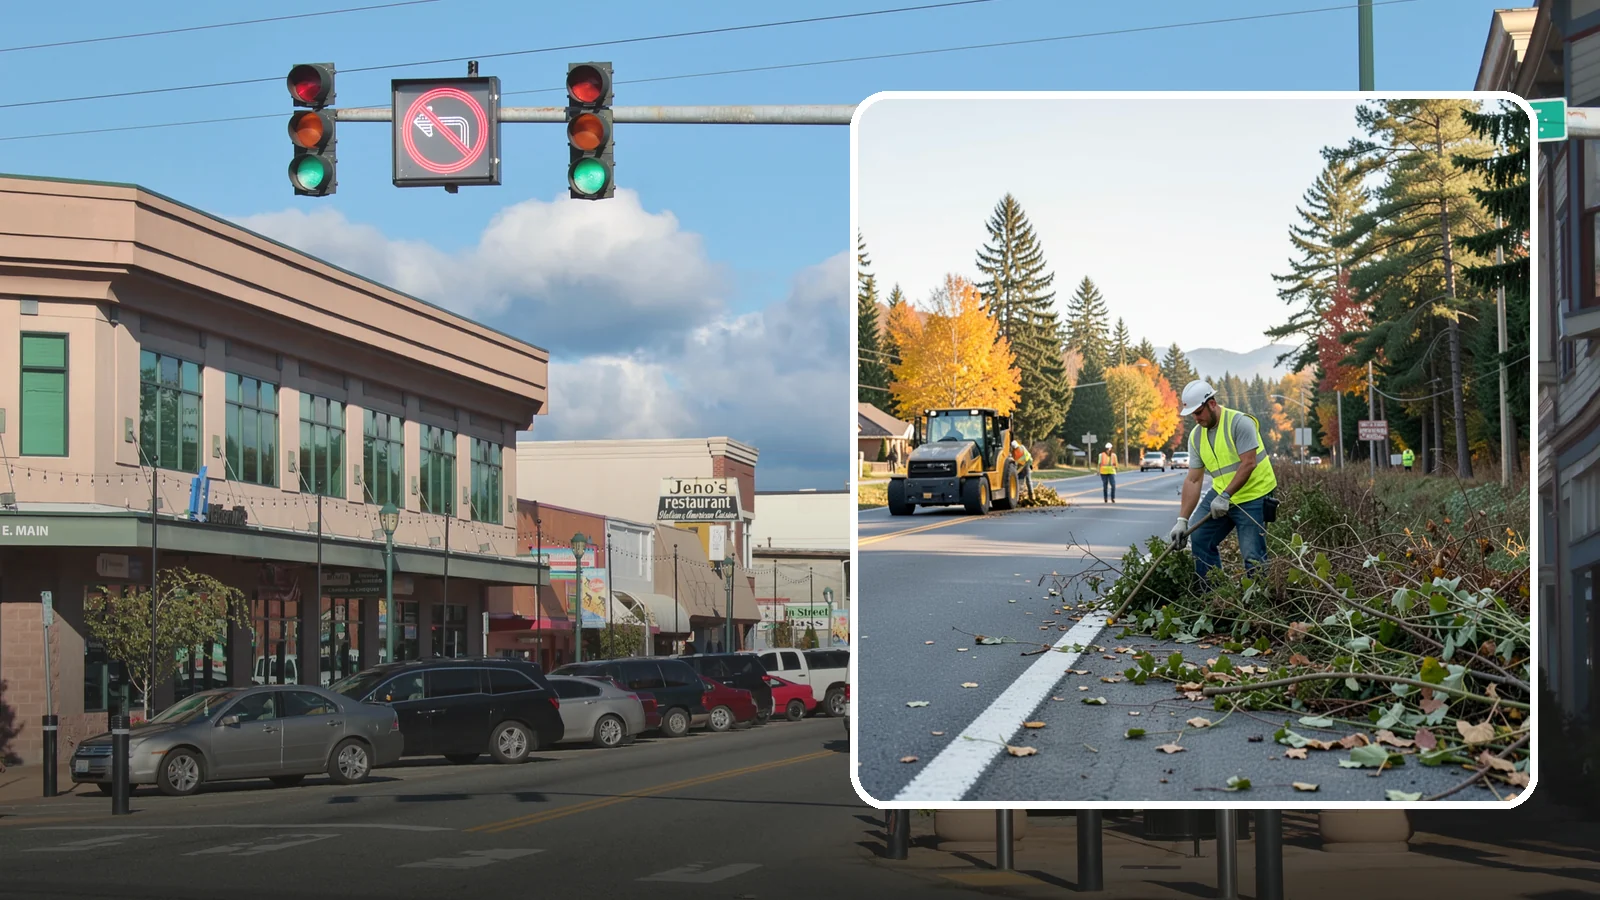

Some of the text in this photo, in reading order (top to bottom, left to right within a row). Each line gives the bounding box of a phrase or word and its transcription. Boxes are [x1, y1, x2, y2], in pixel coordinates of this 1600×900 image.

[670, 480, 727, 494] Jeno's
[665, 496, 731, 509] restaurant
[658, 510, 681, 519] Italian
[685, 509, 715, 519] American
[715, 509, 738, 519] Cuisine
[2, 525, 49, 536] E. MAIN
[797, 607, 829, 616] Street
